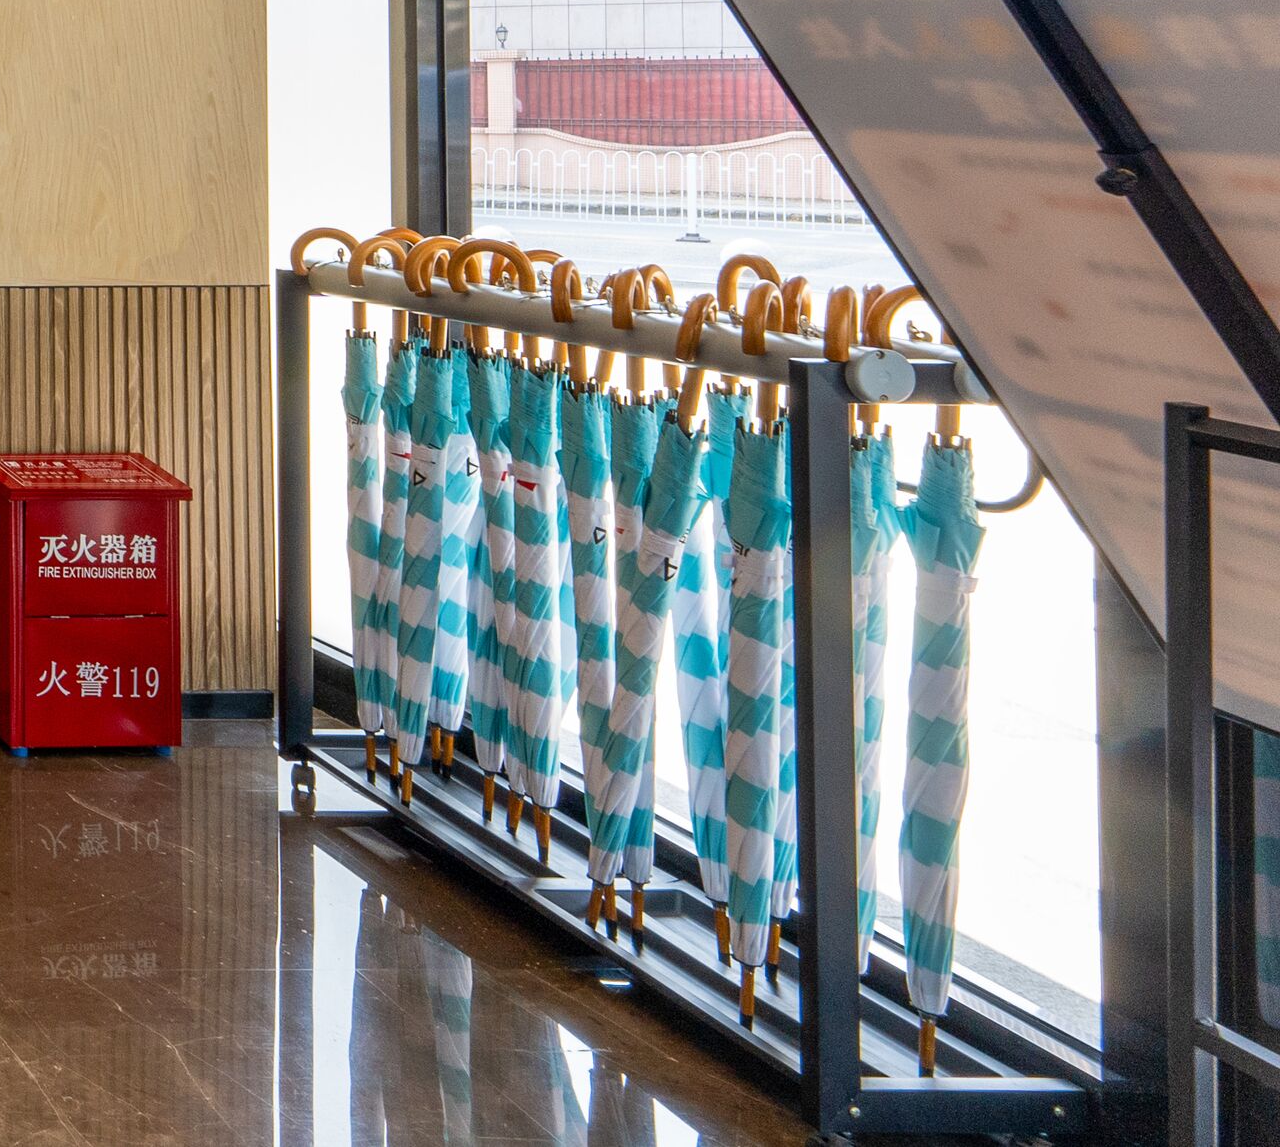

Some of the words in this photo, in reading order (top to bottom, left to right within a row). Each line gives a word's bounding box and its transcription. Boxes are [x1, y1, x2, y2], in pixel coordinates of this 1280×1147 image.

[38, 534, 158, 564] 灭火器箱
[38, 566, 61, 578] FIRE
[63, 566, 134, 579] EXTINGUISHER
[136, 567, 157, 579] BOX
